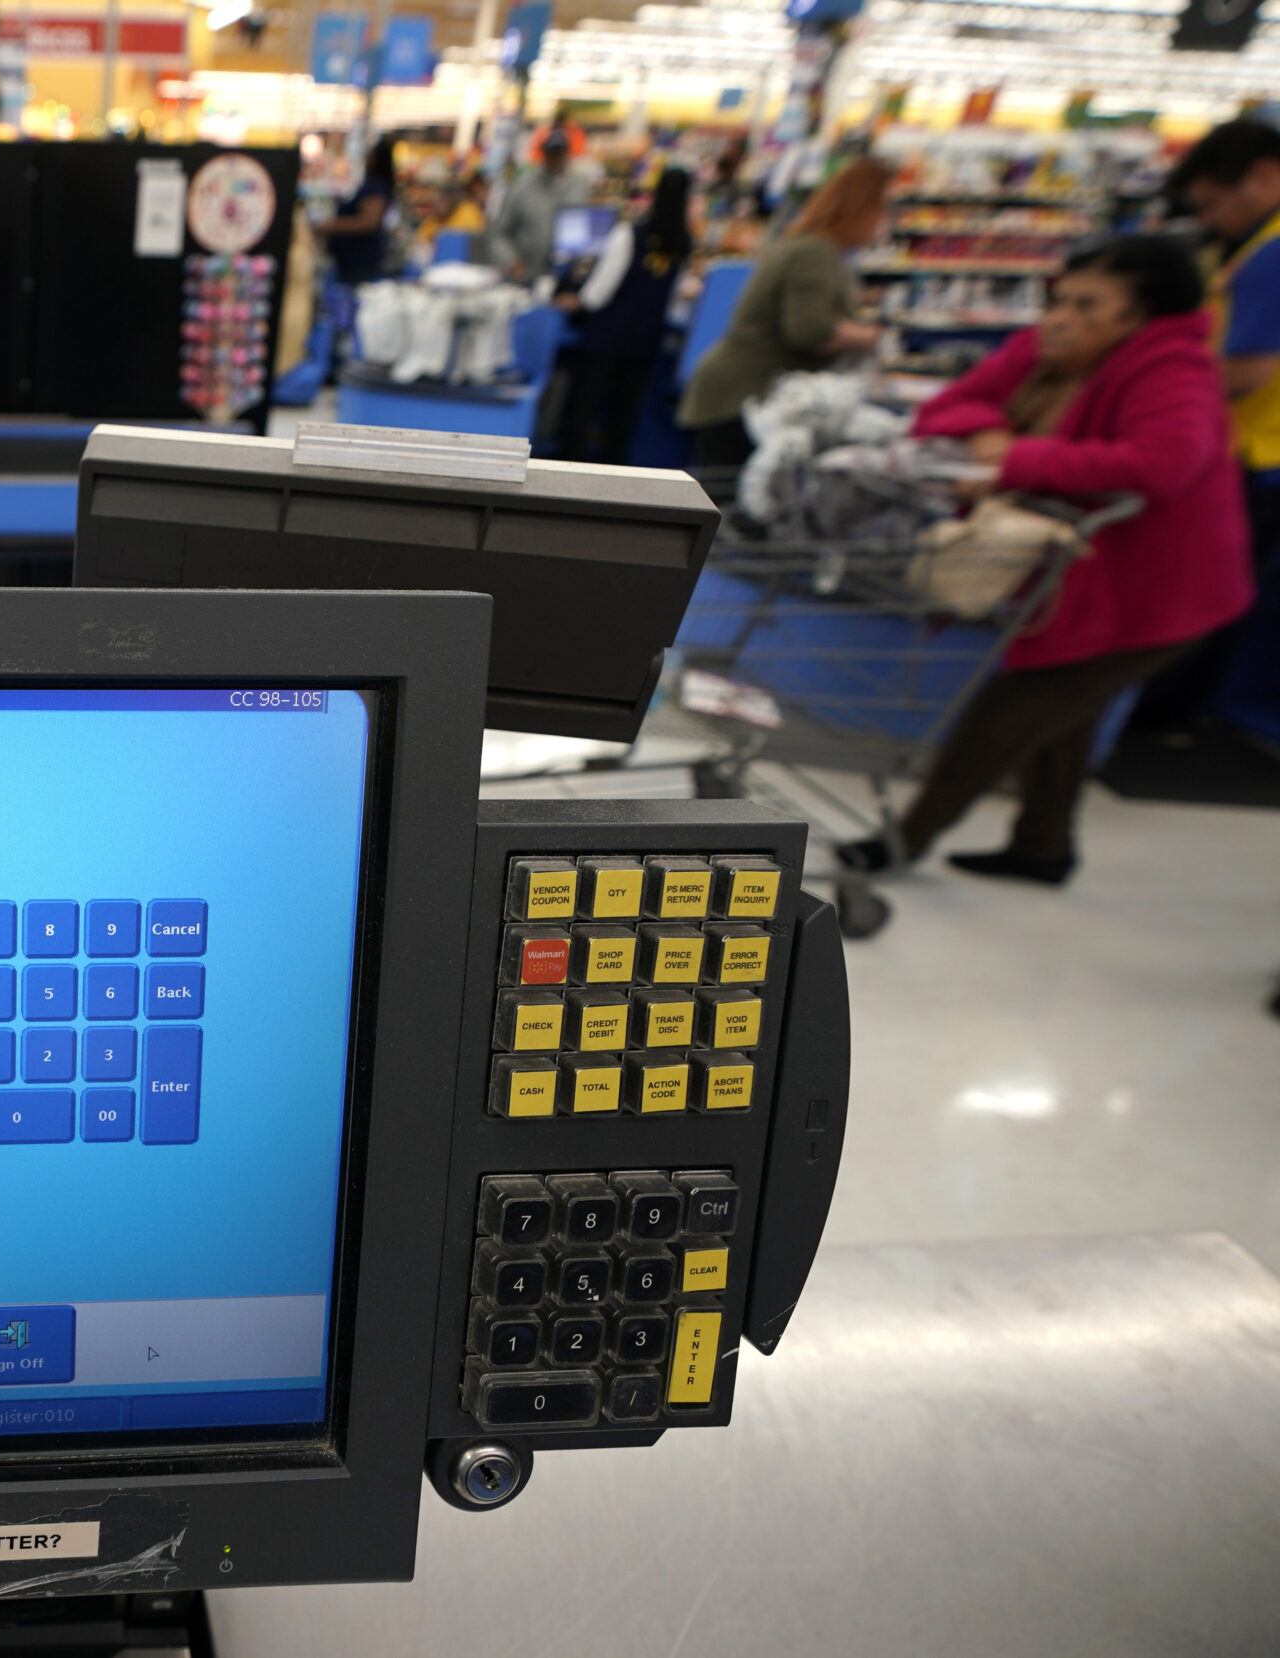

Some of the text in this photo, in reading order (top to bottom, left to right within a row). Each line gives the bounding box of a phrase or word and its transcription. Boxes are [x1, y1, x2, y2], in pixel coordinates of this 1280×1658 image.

[230, 690, 322, 707] CC 98-105
[532, 885, 570, 895] VENDOR
[608, 888, 627, 898] QTY
[666, 884, 704, 894] PS MERC
[743, 885, 765, 894] ITEM
[531, 895, 570, 906] COUPON
[666, 895, 701, 904] RETURN
[734, 895, 771, 905] INQUIRY
[45, 924, 55, 936] 8
[107, 924, 117, 936] 9
[152, 923, 200, 936] Cancel
[527, 950, 565, 960] Walmart
[598, 951, 623, 960] SHOP
[665, 951, 692, 960] PRICE
[730, 951, 758, 960] ERROR
[596, 961, 622, 970] CARD
[664, 961, 689, 970] OVER
[724, 961, 762, 970] CORRECT
[44, 988, 54, 1000] 5
[105, 987, 115, 999] 6
[157, 986, 191, 999] Back
[586, 1019, 619, 1029] CREDIT
[655, 1015, 684, 1025] TRANS
[726, 1015, 748, 1024] VOID
[522, 1022, 553, 1031] CHECK
[658, 1025, 679, 1034] DISC
[725, 1025, 747, 1034] ITEM
[589, 1029, 615, 1038] DEBIT
[43, 1050, 52, 1062] 2
[104, 1049, 113, 1061] 3
[152, 1080, 190, 1093] Enter
[582, 1083, 610, 1092] TOTAL
[648, 1079, 681, 1090] ACTION
[714, 1077, 745, 1087] ABORT
[519, 1087, 544, 1096] CASH
[651, 1089, 676, 1099] CODE
[713, 1086, 744, 1096] TRANS
[12, 1112, 21, 1124] 0
[98, 1110, 117, 1122] 00
[700, 1201, 728, 1215] Ctrl
[585, 1212, 597, 1229] 8
[648, 1208, 660, 1224] 9
[520, 1215, 532, 1231] 7
[689, 1266, 718, 1275] CLEAR
[513, 1277, 525, 1292] 4
[577, 1274, 589, 1291] 5
[641, 1273, 653, 1288] 6
[509, 1336, 517, 1351] 1
[571, 1334, 583, 1349] 2
[635, 1331, 646, 1346] 3
[19, 1356, 45, 1369] Off
[687, 1329, 701, 1385] ENTER
[534, 1395, 545, 1410] 0
